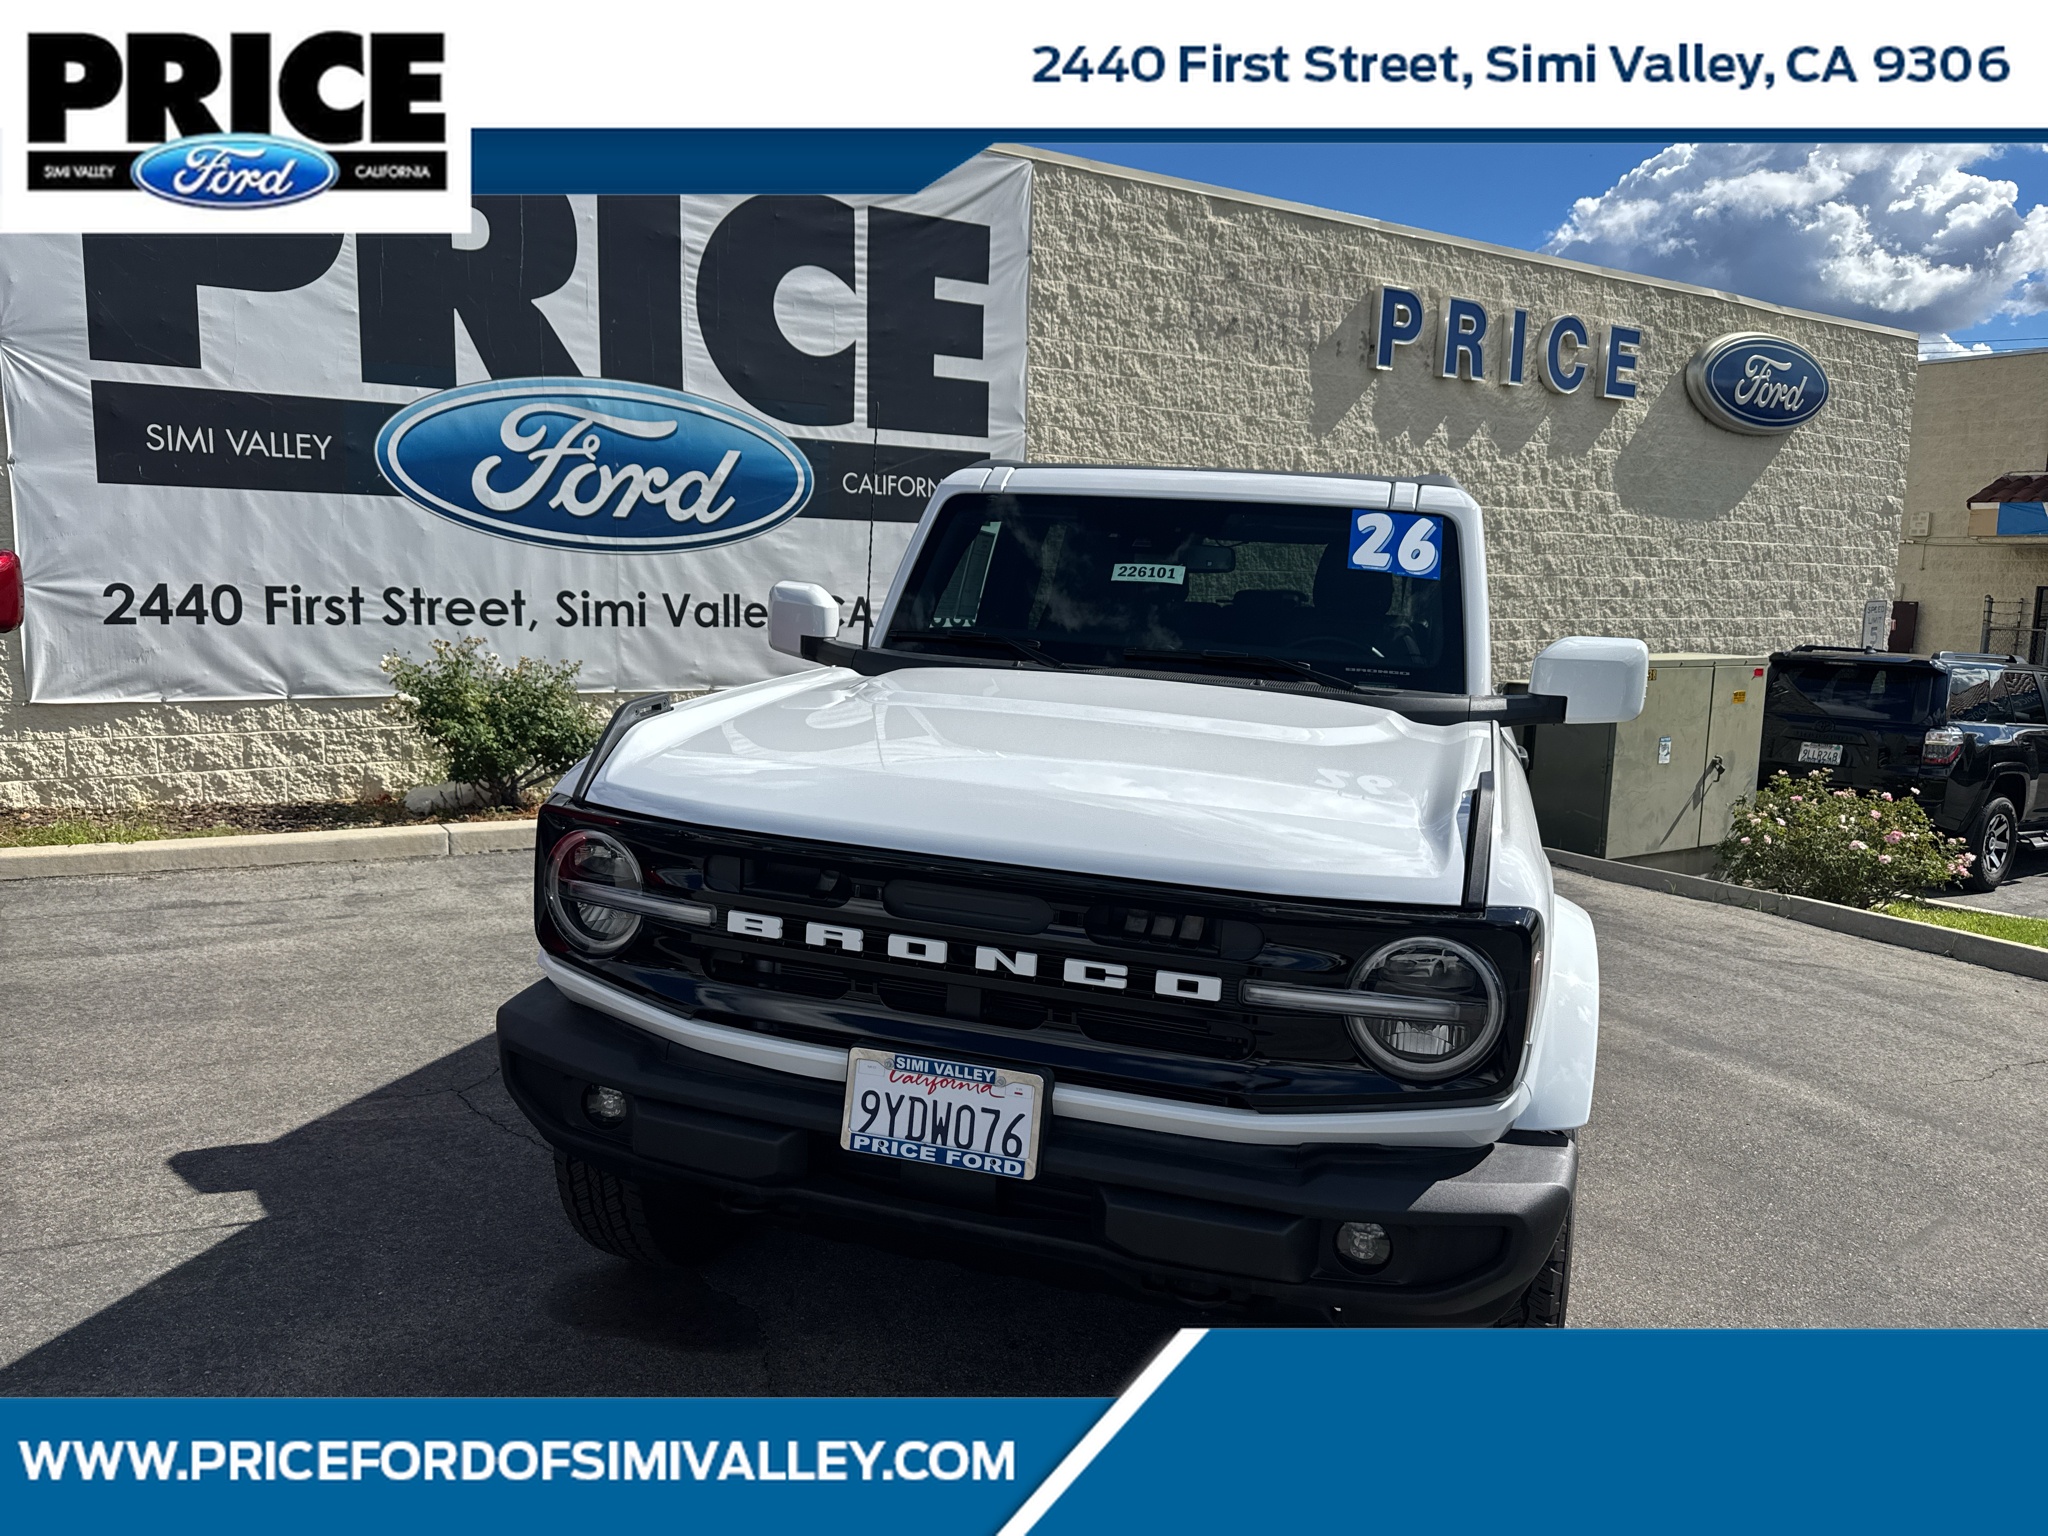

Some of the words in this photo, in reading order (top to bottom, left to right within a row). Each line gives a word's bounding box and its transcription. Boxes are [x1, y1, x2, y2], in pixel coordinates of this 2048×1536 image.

[1368, 284, 1643, 400] PRICE
[1734, 354, 1808, 413] Ford
[146, 424, 214, 453] SIMI
[226, 429, 332, 461] VALLEY
[471, 402, 742, 524] Ford
[1352, 513, 1439, 575] 26
[1117, 566, 1175, 579] 226101
[103, 583, 243, 626] 2440
[265, 584, 364, 626] First
[382, 587, 538, 632] Street,
[556, 590, 646, 627] Simi
[1870, 627, 1877, 644] 5
[727, 909, 1222, 1002] BRONCO
[889, 1070, 1005, 1098] California
[896, 1057, 929, 1073] SIMI
[934, 1063, 994, 1082] VALLEY
[859, 1090, 1026, 1158] 9YDW076
[853, 1136, 936, 1161] PRICE
[946, 1150, 1022, 1175] FORD
